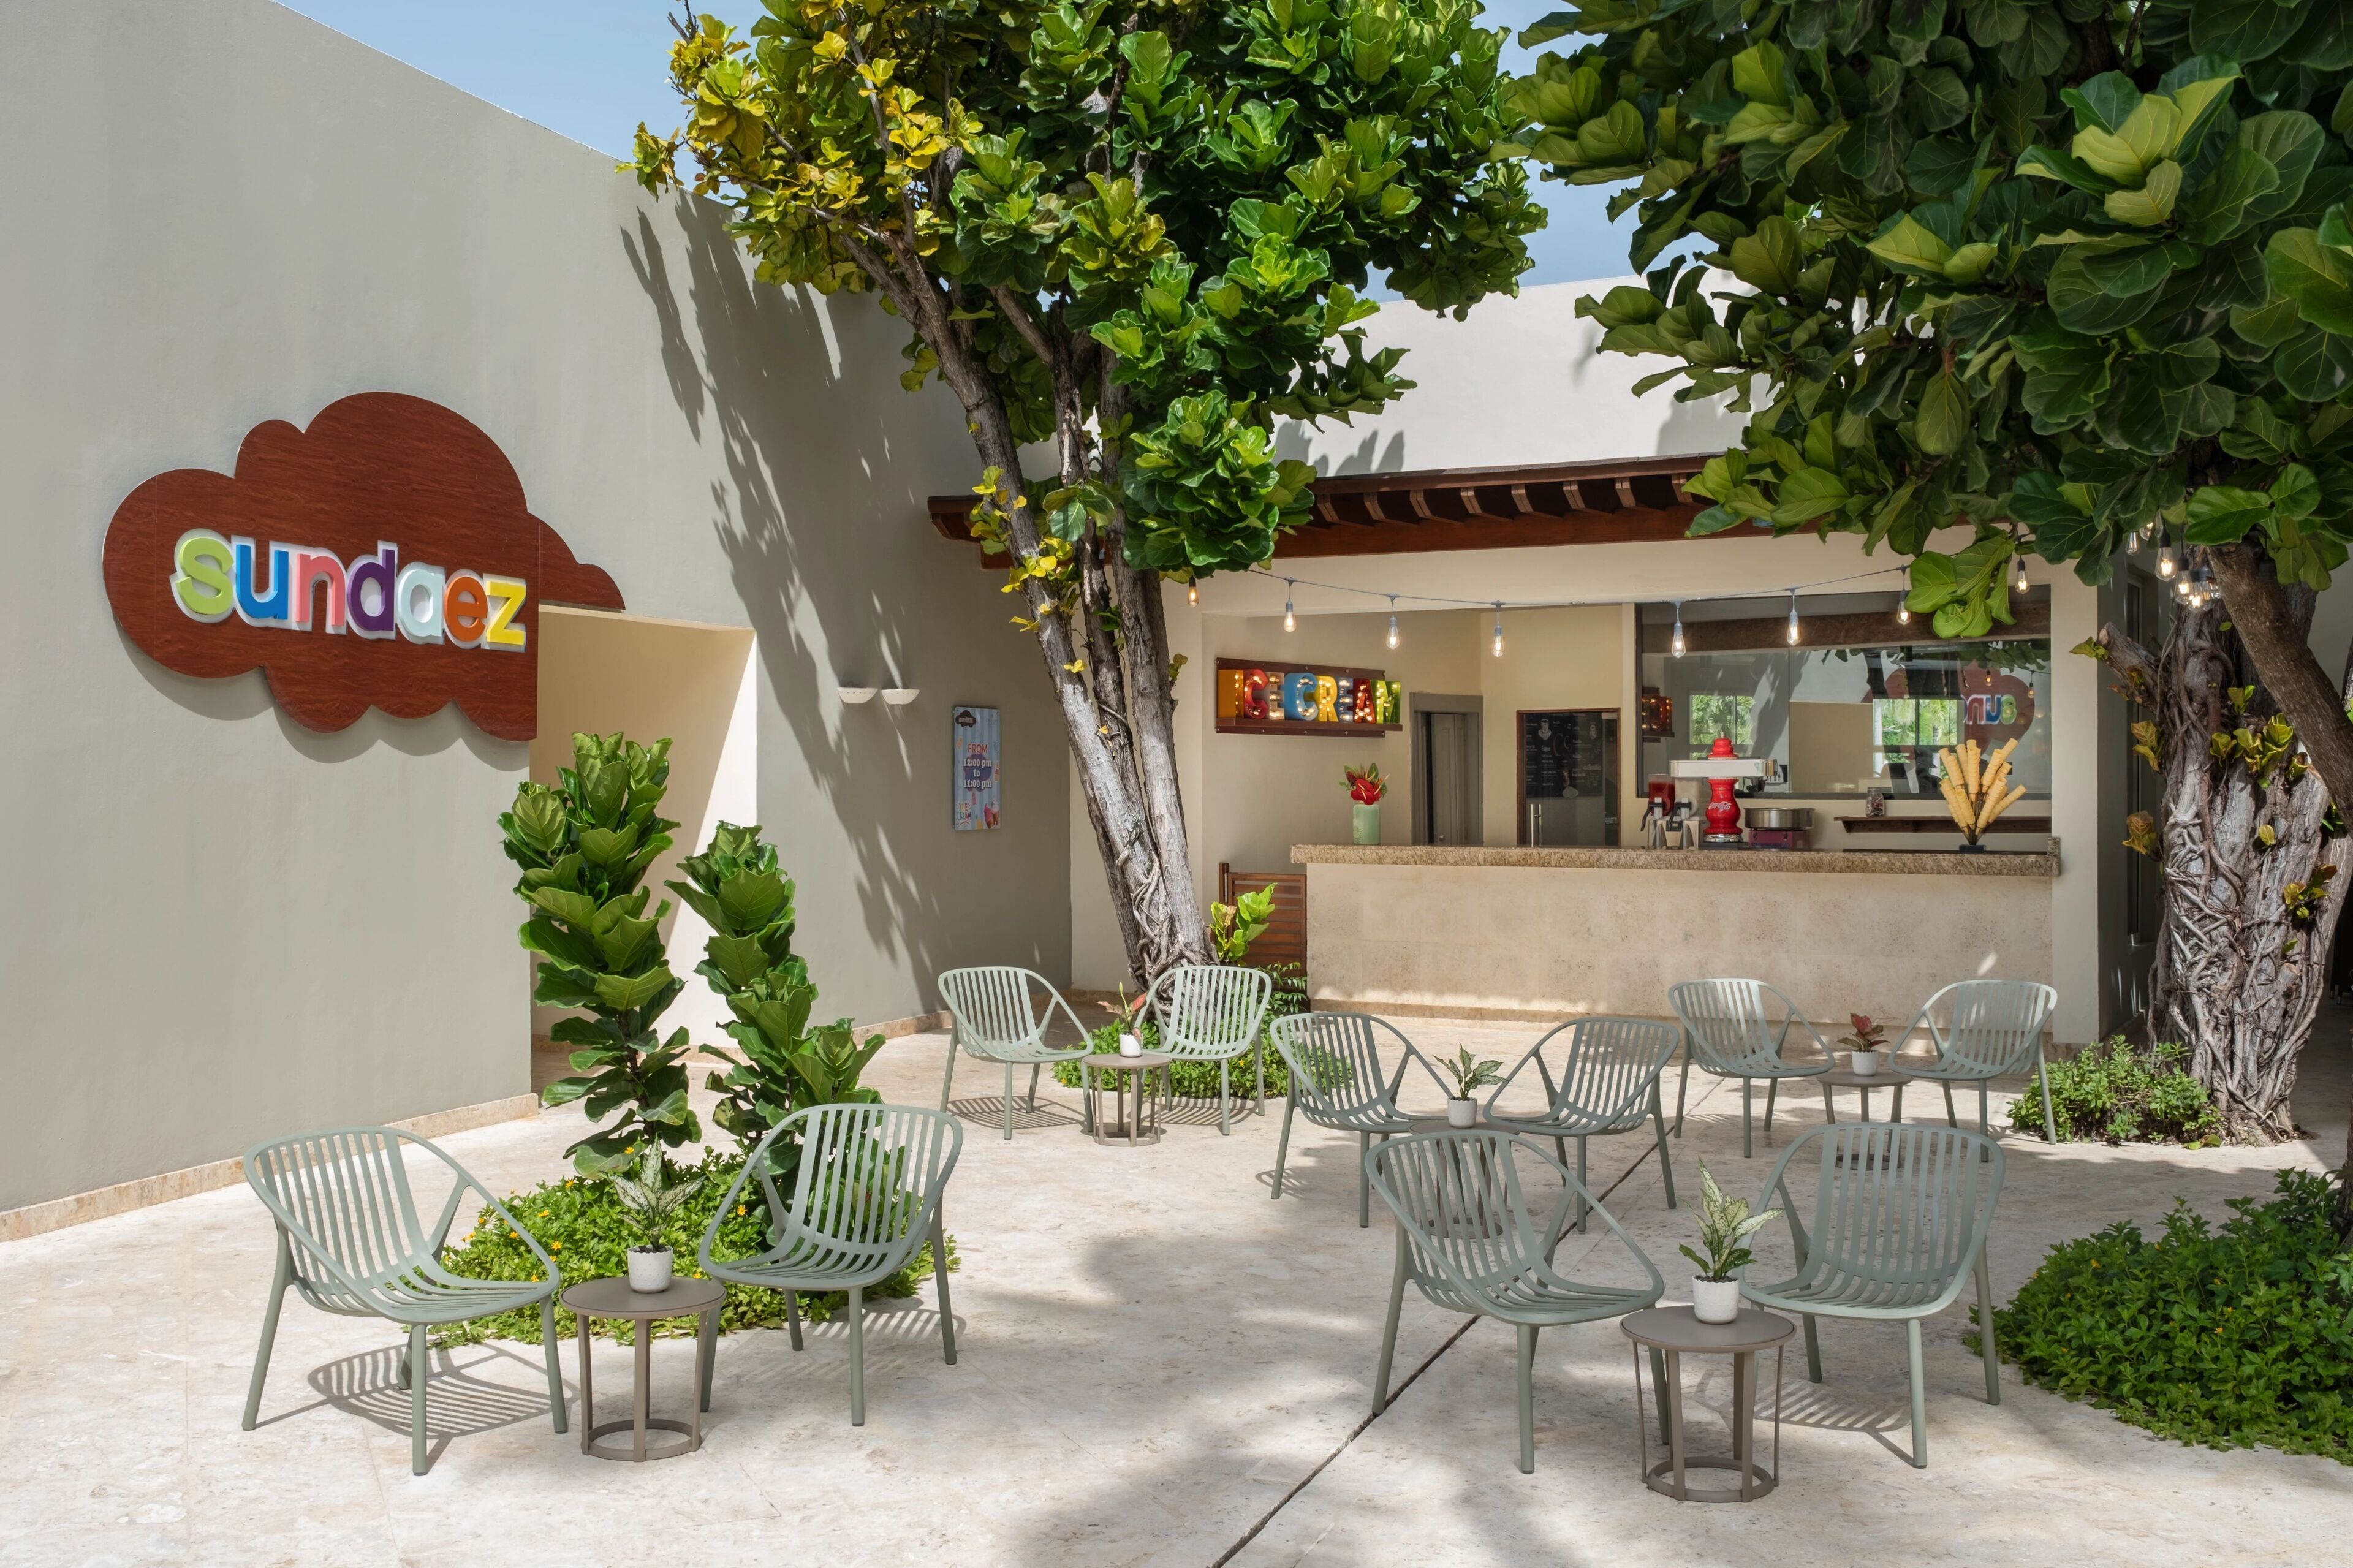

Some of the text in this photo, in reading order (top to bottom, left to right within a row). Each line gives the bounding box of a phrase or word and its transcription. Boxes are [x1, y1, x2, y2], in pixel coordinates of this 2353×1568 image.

[172, 531, 526, 651] sundaez
[968, 744, 988, 753] FROM
[982, 760, 991, 768] pm
[973, 768, 980, 777] to
[982, 781, 991, 789] pm
